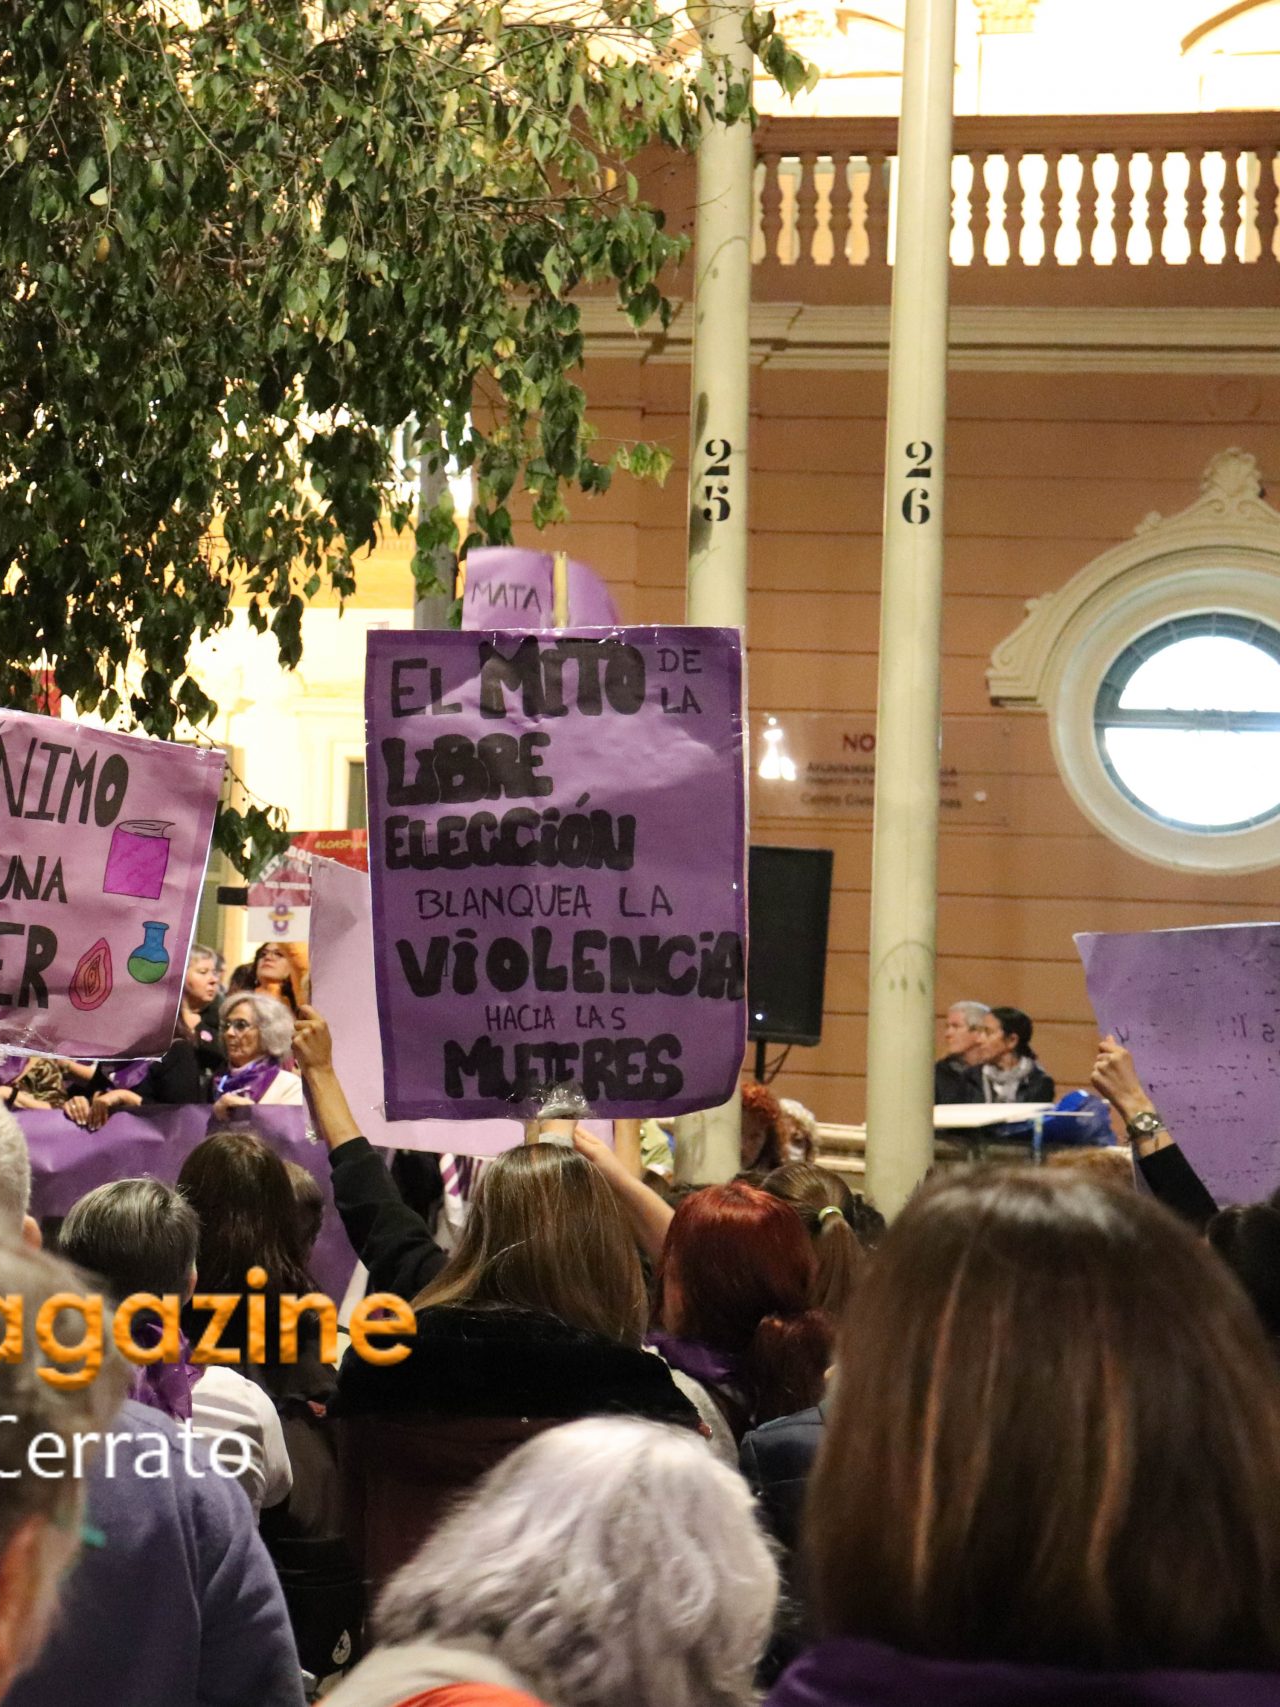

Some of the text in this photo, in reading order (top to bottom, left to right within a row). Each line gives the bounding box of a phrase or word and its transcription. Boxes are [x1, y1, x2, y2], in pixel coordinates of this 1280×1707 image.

[471, 581, 543, 613] MATA
[391, 635, 703, 720] EL MITO DE
[661, 685, 703, 714] LA
[416, 884, 674, 919] BLANQUEA LA
[485, 1004, 626, 1031] HACIA LAS
